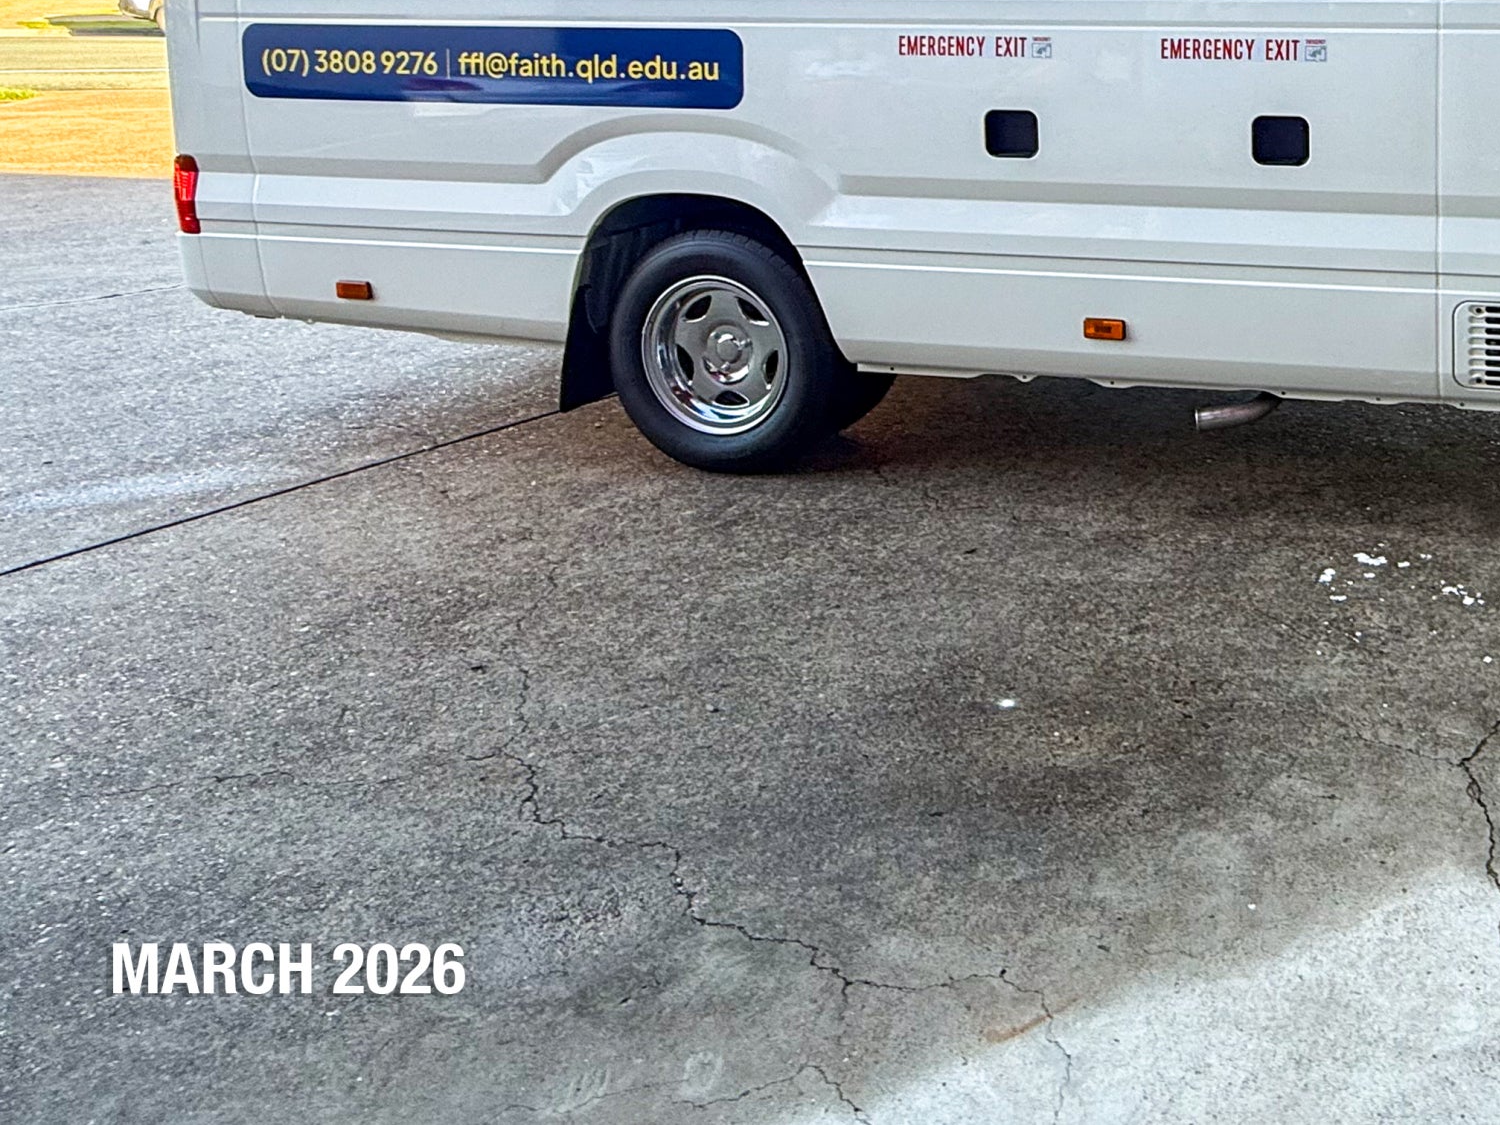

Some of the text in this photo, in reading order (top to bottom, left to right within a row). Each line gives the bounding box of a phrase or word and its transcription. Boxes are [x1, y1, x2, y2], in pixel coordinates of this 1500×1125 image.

[898, 36, 1027, 58] EMERGENCY EXIT
[1161, 38, 1299, 62] EMERGENCY EXIT
[261, 49, 720, 83] (07) 3808 9276 ffl@faith.qld.edu.au
